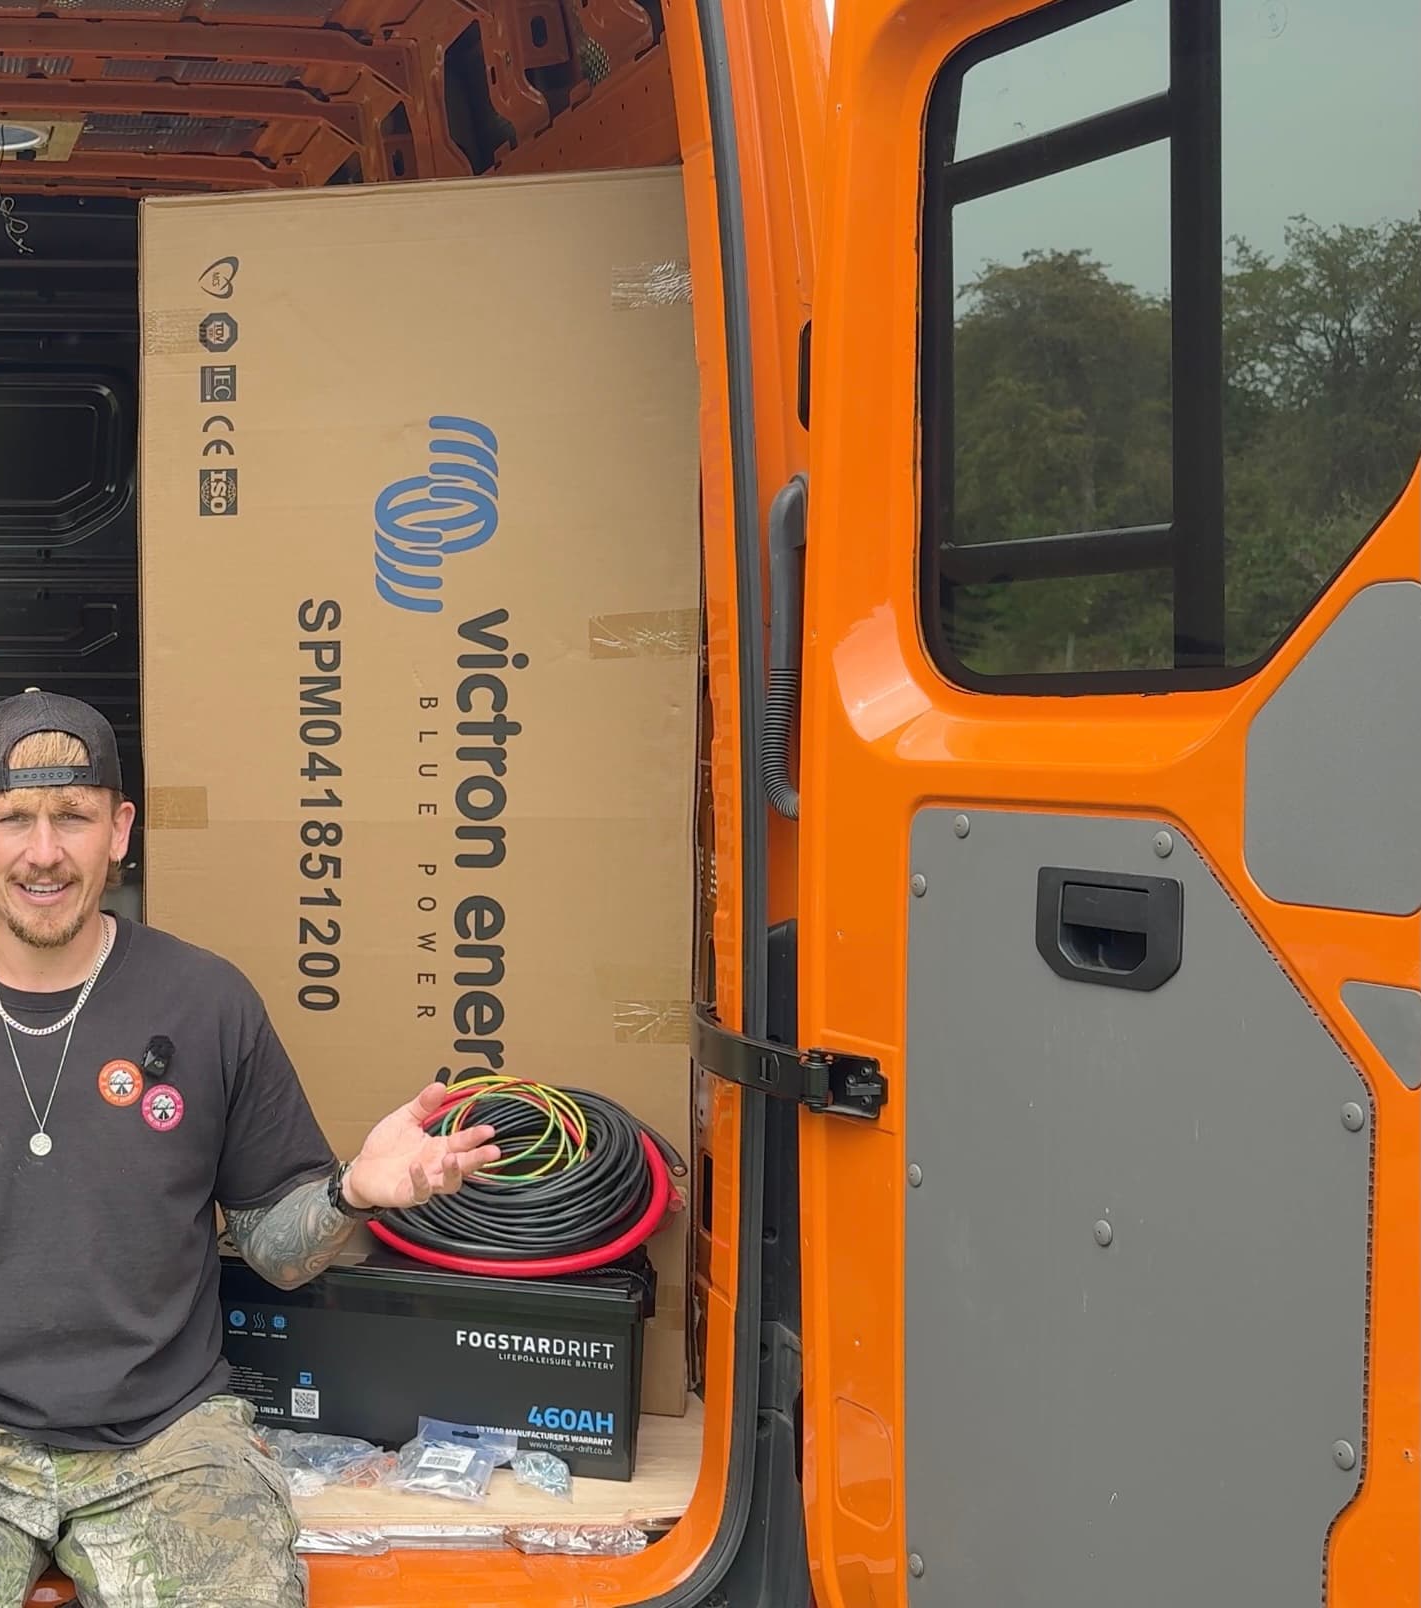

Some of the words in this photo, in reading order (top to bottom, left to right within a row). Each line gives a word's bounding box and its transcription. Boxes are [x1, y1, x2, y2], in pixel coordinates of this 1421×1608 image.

[213, 366, 231, 400] IEC
[202, 415, 235, 457] CE
[209, 470, 228, 514] ISO
[417, 696, 439, 816] BLUE
[455, 608, 529, 869] victron
[297, 598, 343, 1012] SPM041851200
[416, 863, 438, 1019] POWER
[435, 894, 506, 1086] ener
[499, 1353, 535, 1363] LIFEPO4
[536, 1356, 572, 1367] LEISURE
[575, 1359, 614, 1371] BATTERY
[486, 1427, 504, 1435] YEAR
[505, 1428, 570, 1442] MANUFACTURER'S
[570, 1434, 613, 1446] WARRANTY
[528, 1406, 614, 1434] 460AH
